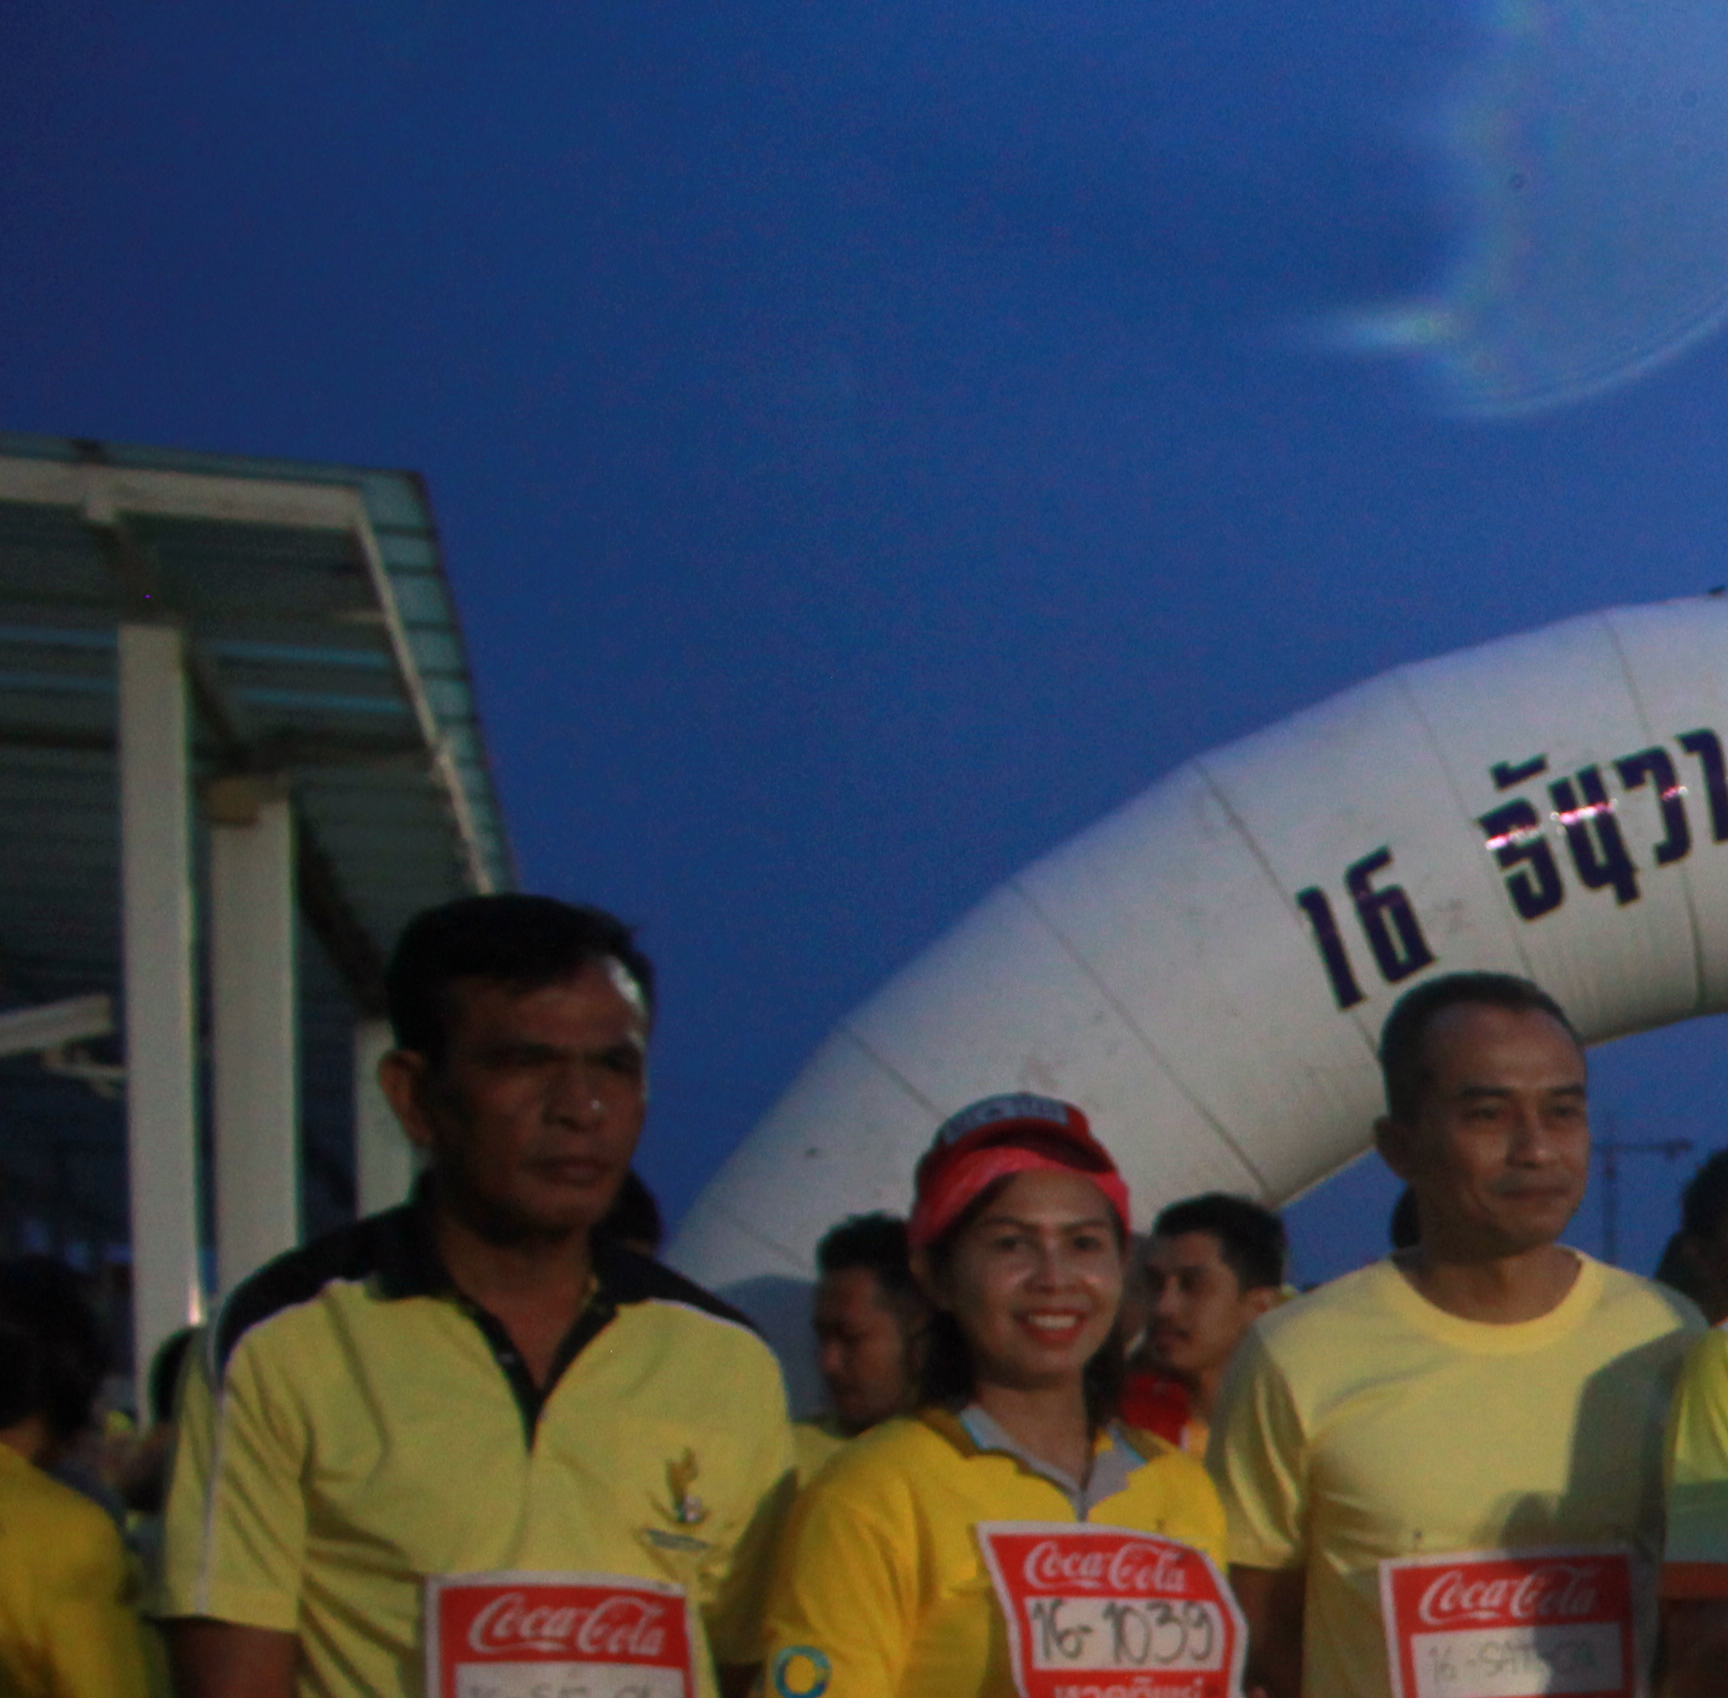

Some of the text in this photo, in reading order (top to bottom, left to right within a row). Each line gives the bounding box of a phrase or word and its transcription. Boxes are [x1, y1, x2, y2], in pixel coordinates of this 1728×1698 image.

[1296, 845, 1440, 1010] 16
[1022, 1540, 1189, 1592] Coca-Cola
[1417, 1563, 1601, 1627] Coca-Cola
[466, 1591, 668, 1657] Coca-Cola
